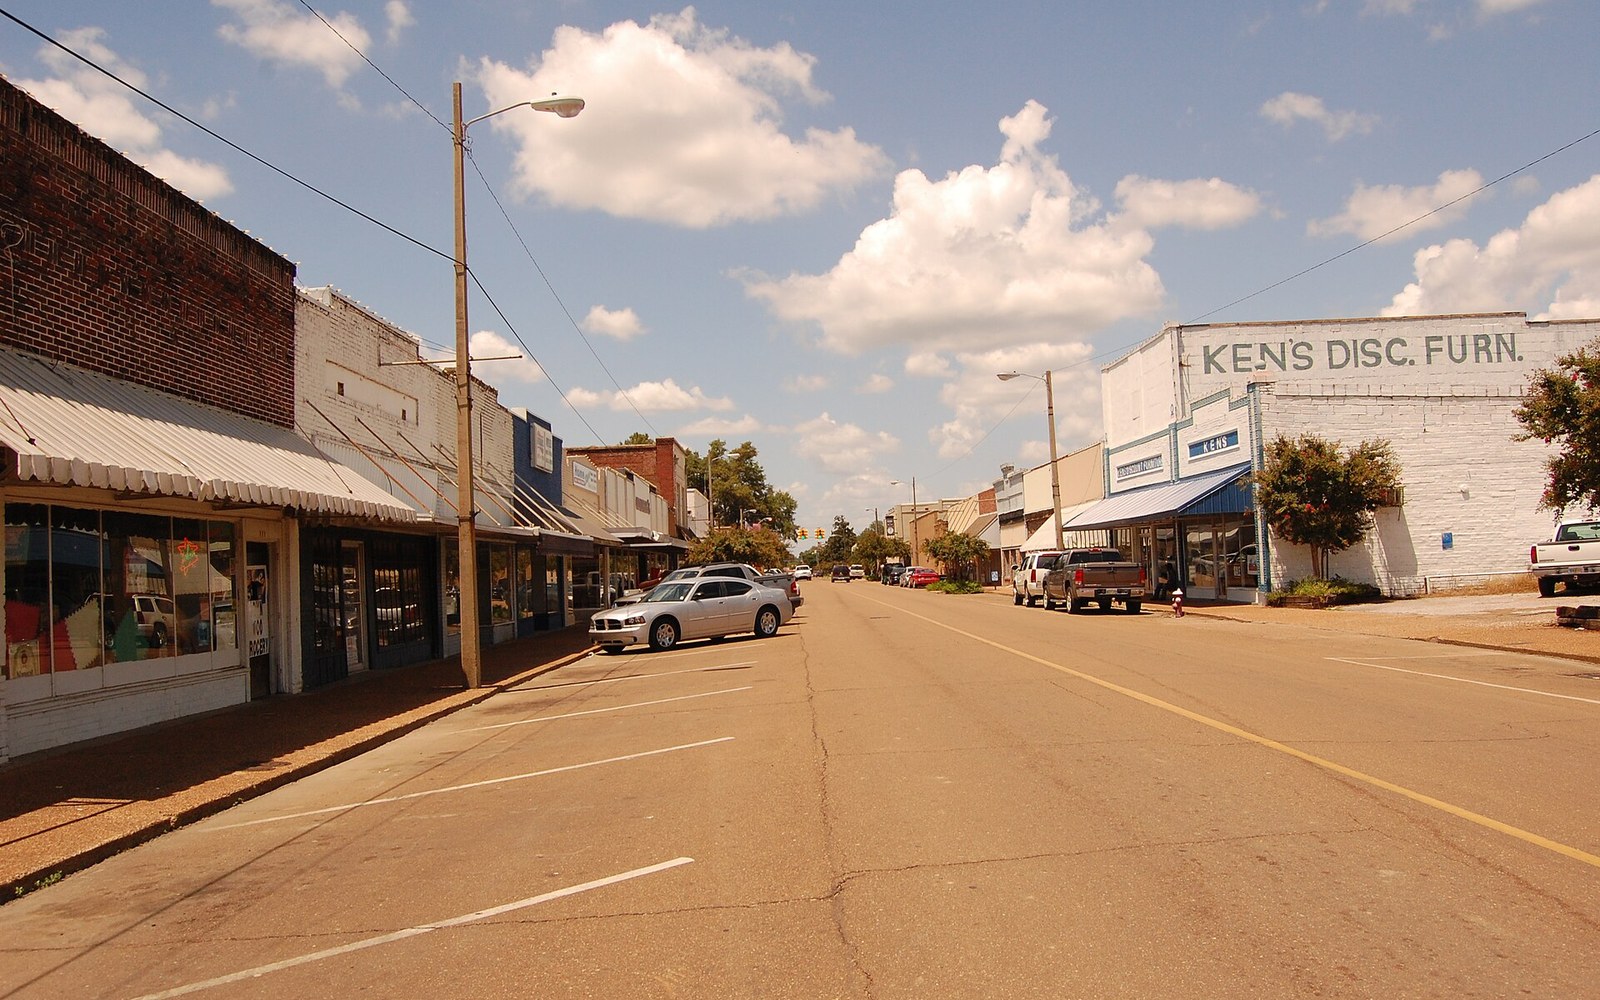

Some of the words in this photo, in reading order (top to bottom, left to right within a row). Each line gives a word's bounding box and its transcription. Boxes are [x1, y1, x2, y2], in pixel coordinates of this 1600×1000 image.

[1202, 338, 1314, 374] KEN'S
[1327, 337, 1416, 369] DISC.
[1425, 332, 1524, 364] FURN.
[1203, 435, 1228, 453] KENS
